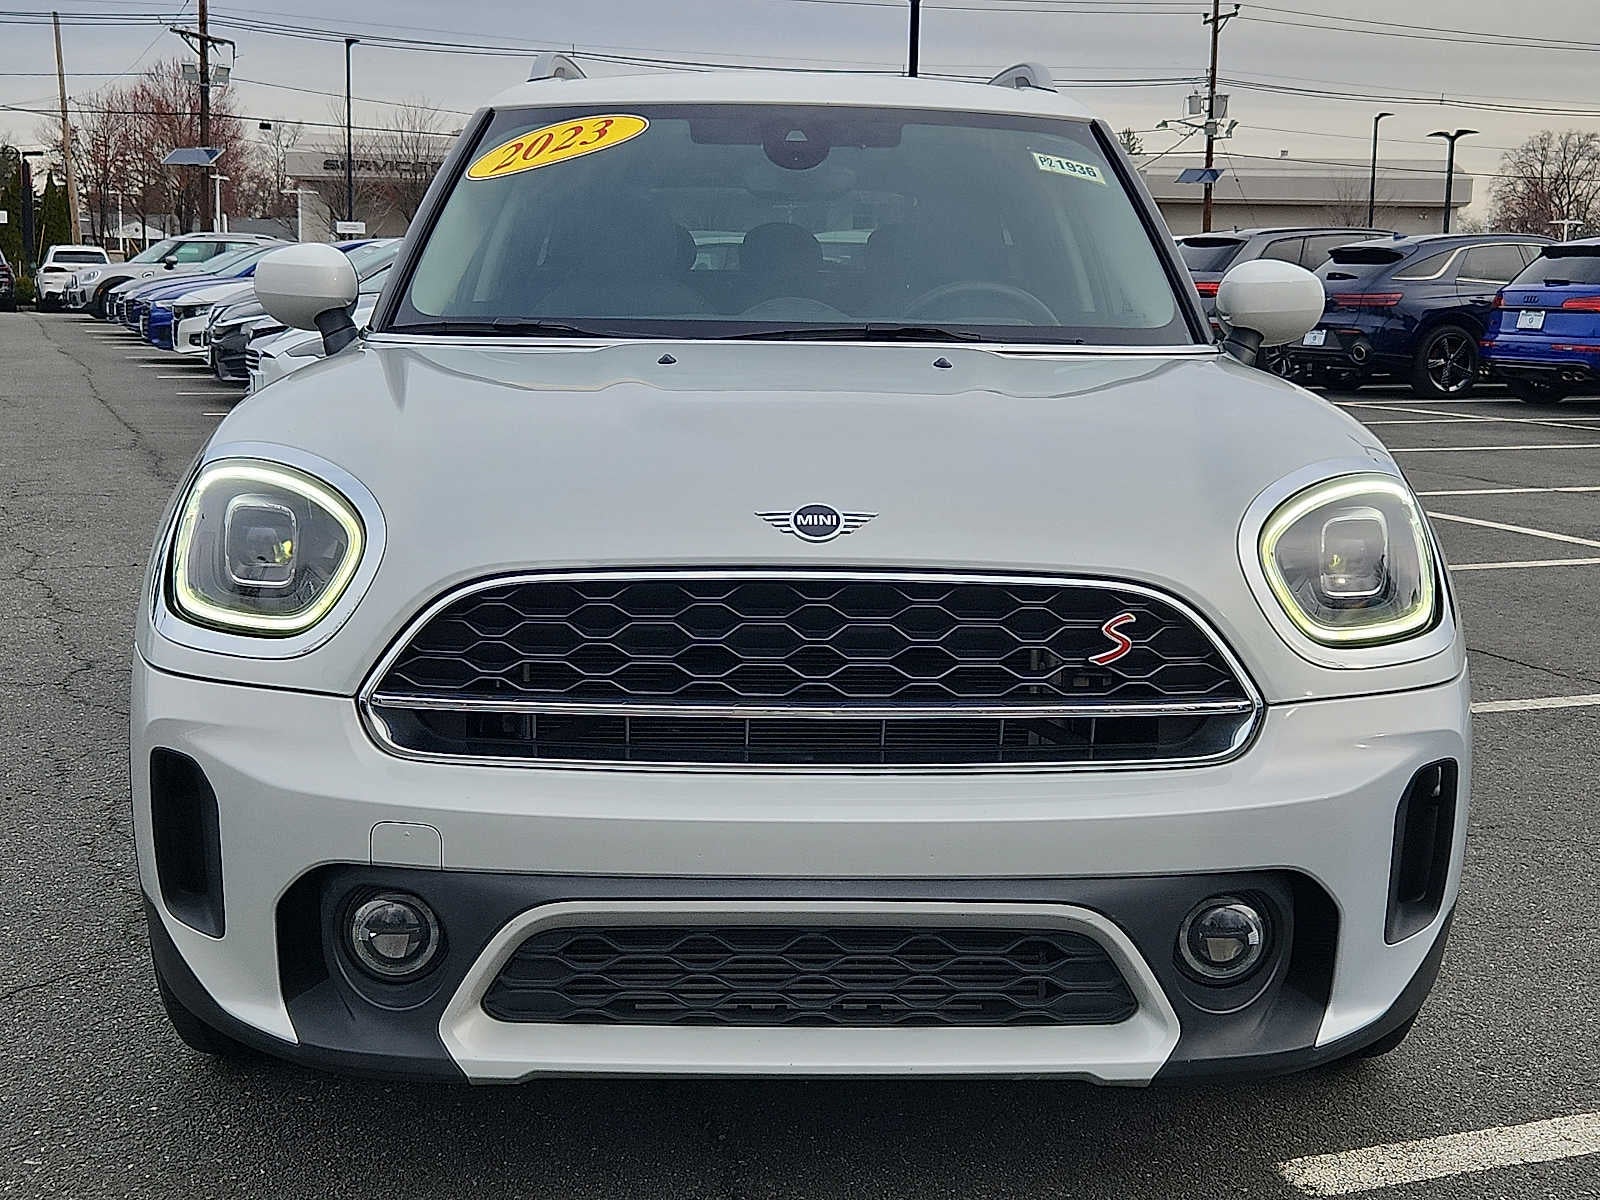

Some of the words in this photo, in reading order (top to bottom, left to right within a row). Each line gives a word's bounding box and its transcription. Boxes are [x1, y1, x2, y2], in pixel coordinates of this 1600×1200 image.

[489, 119, 614, 173] 2023
[796, 514, 837, 526] MINI
[1088, 613, 1136, 665] S
